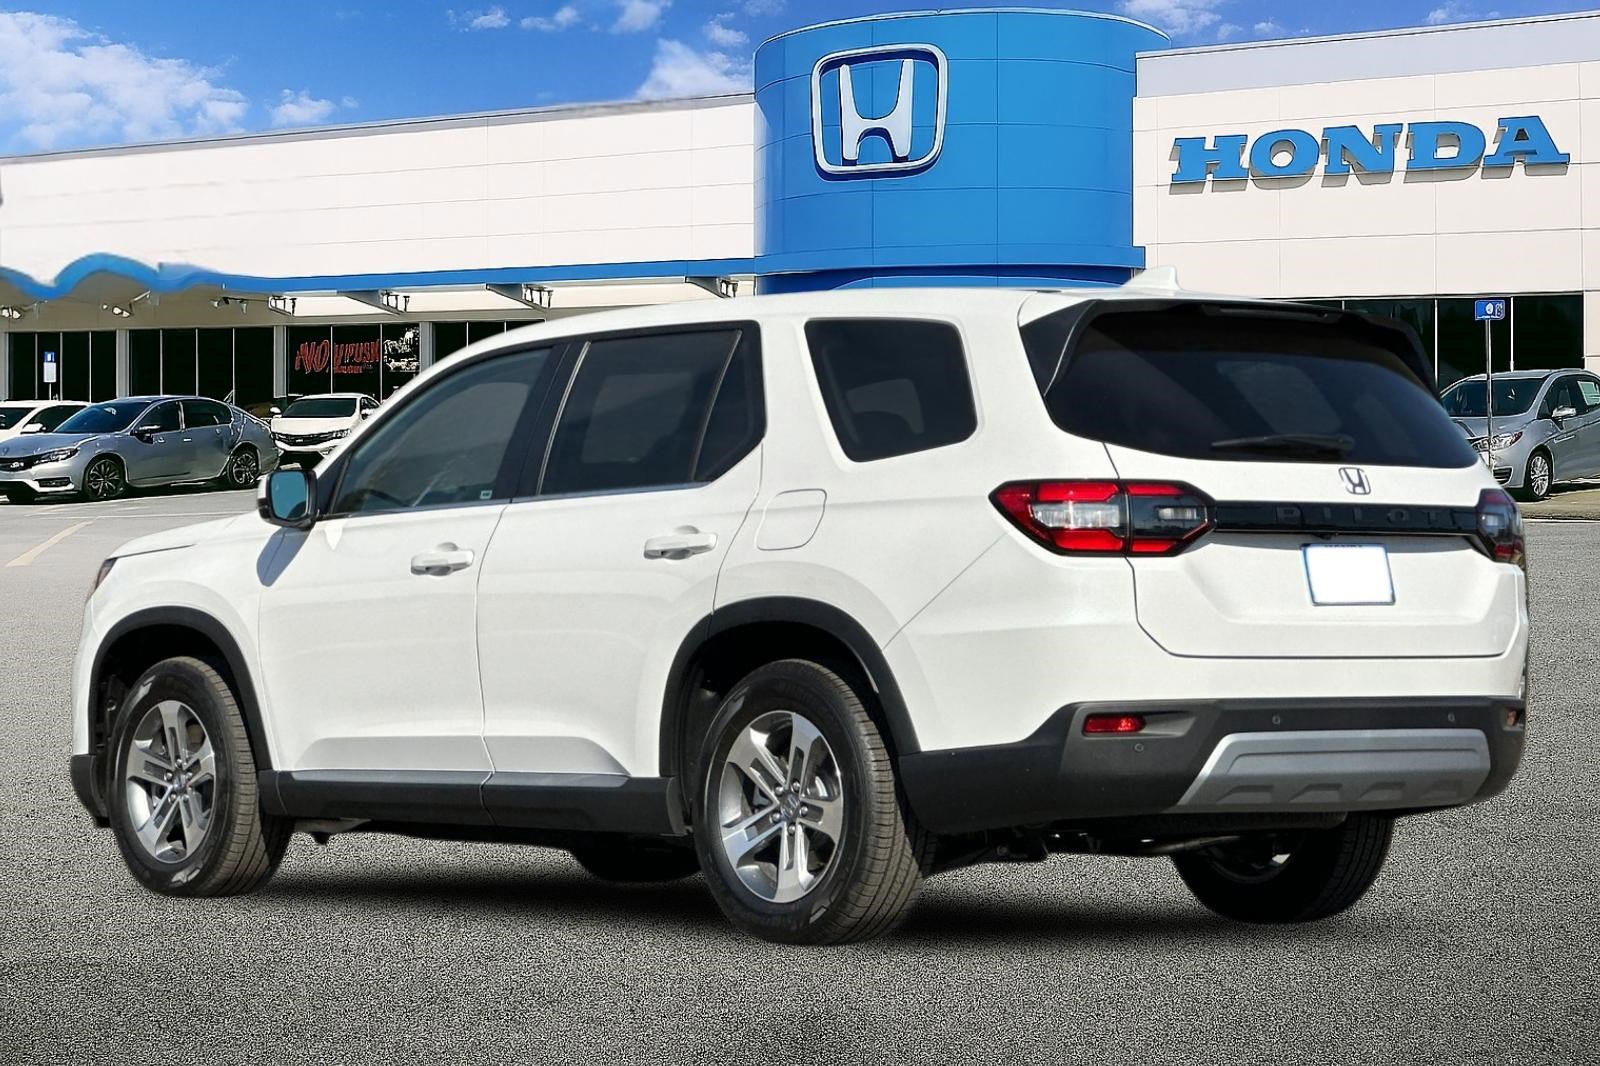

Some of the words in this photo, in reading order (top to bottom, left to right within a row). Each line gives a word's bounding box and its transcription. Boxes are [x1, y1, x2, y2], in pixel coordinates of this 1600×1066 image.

[1171, 115, 1571, 184] HONDA
[295, 339, 330, 374] NO
[1275, 505, 1445, 525] PILOT
